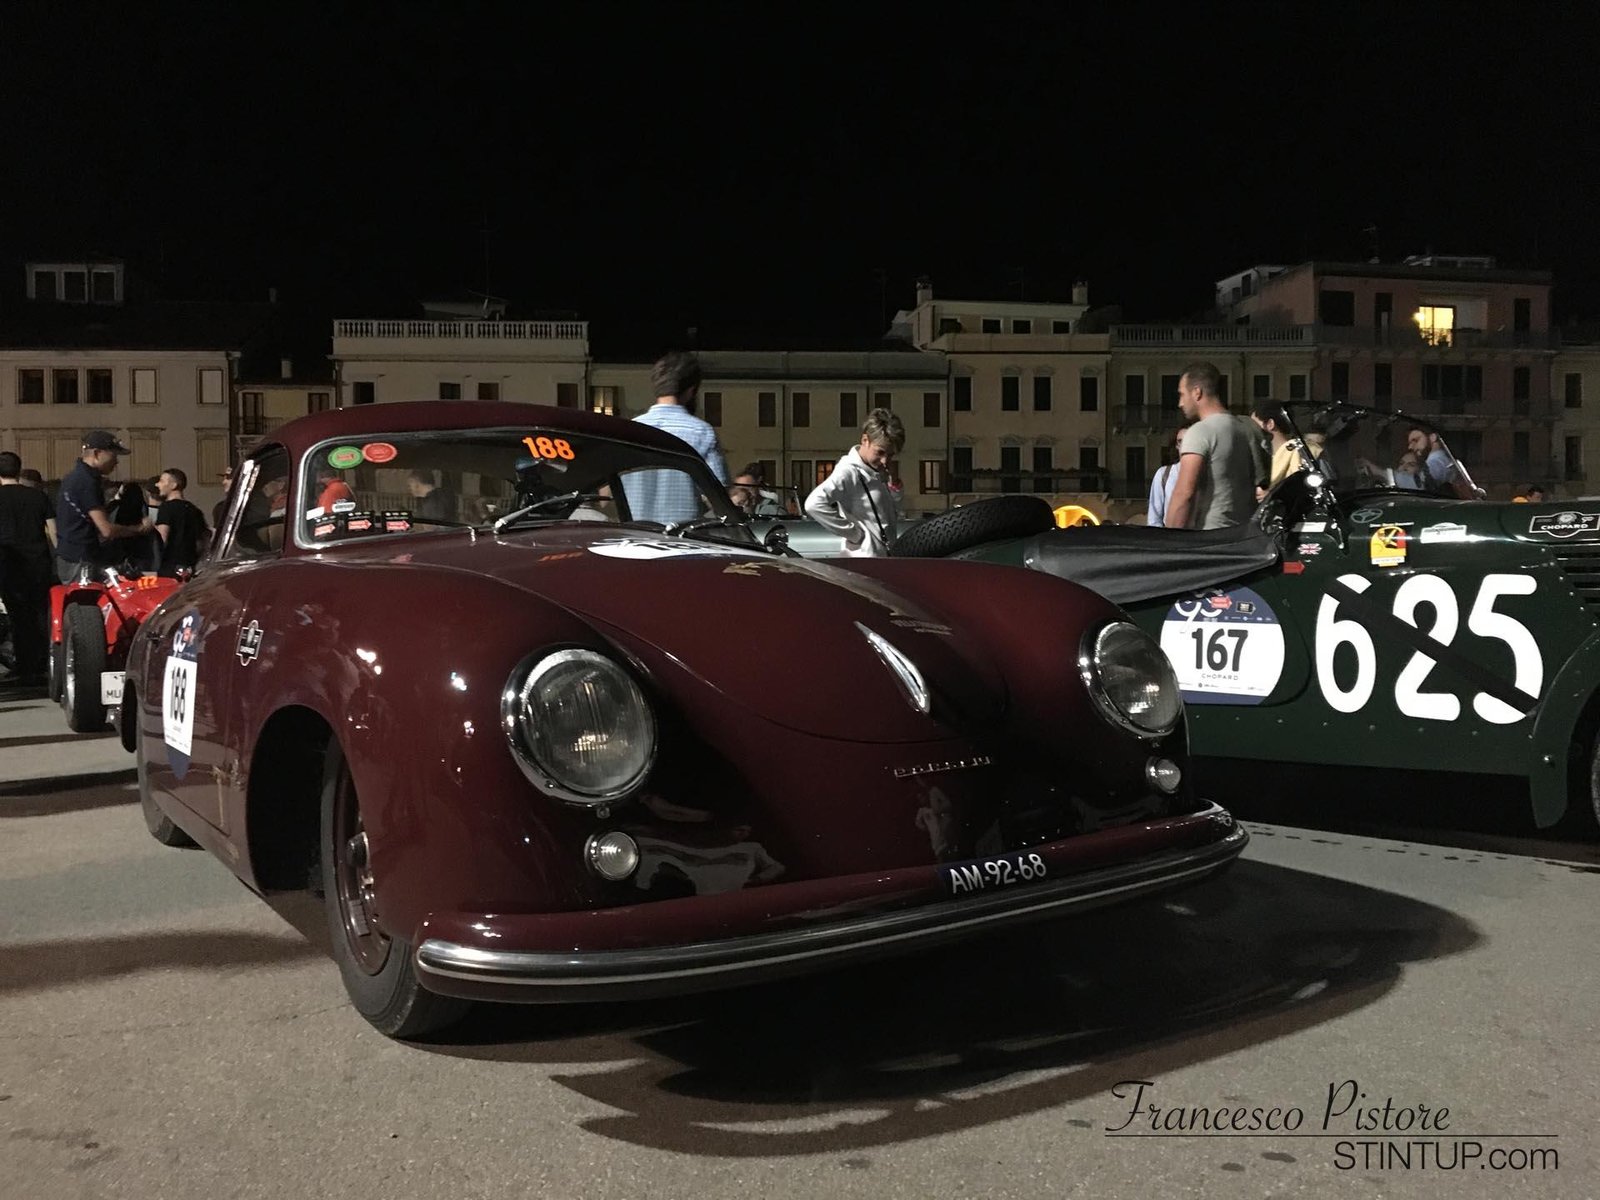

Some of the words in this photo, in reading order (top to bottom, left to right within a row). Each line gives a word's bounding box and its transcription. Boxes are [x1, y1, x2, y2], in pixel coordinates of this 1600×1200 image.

[522, 436, 576, 460] 188
[1191, 628, 1249, 672] 167
[1315, 574, 1543, 725] 625
[1201, 673, 1239, 681] CHOPARD
[949, 853, 1047, 894] AM-92-68
